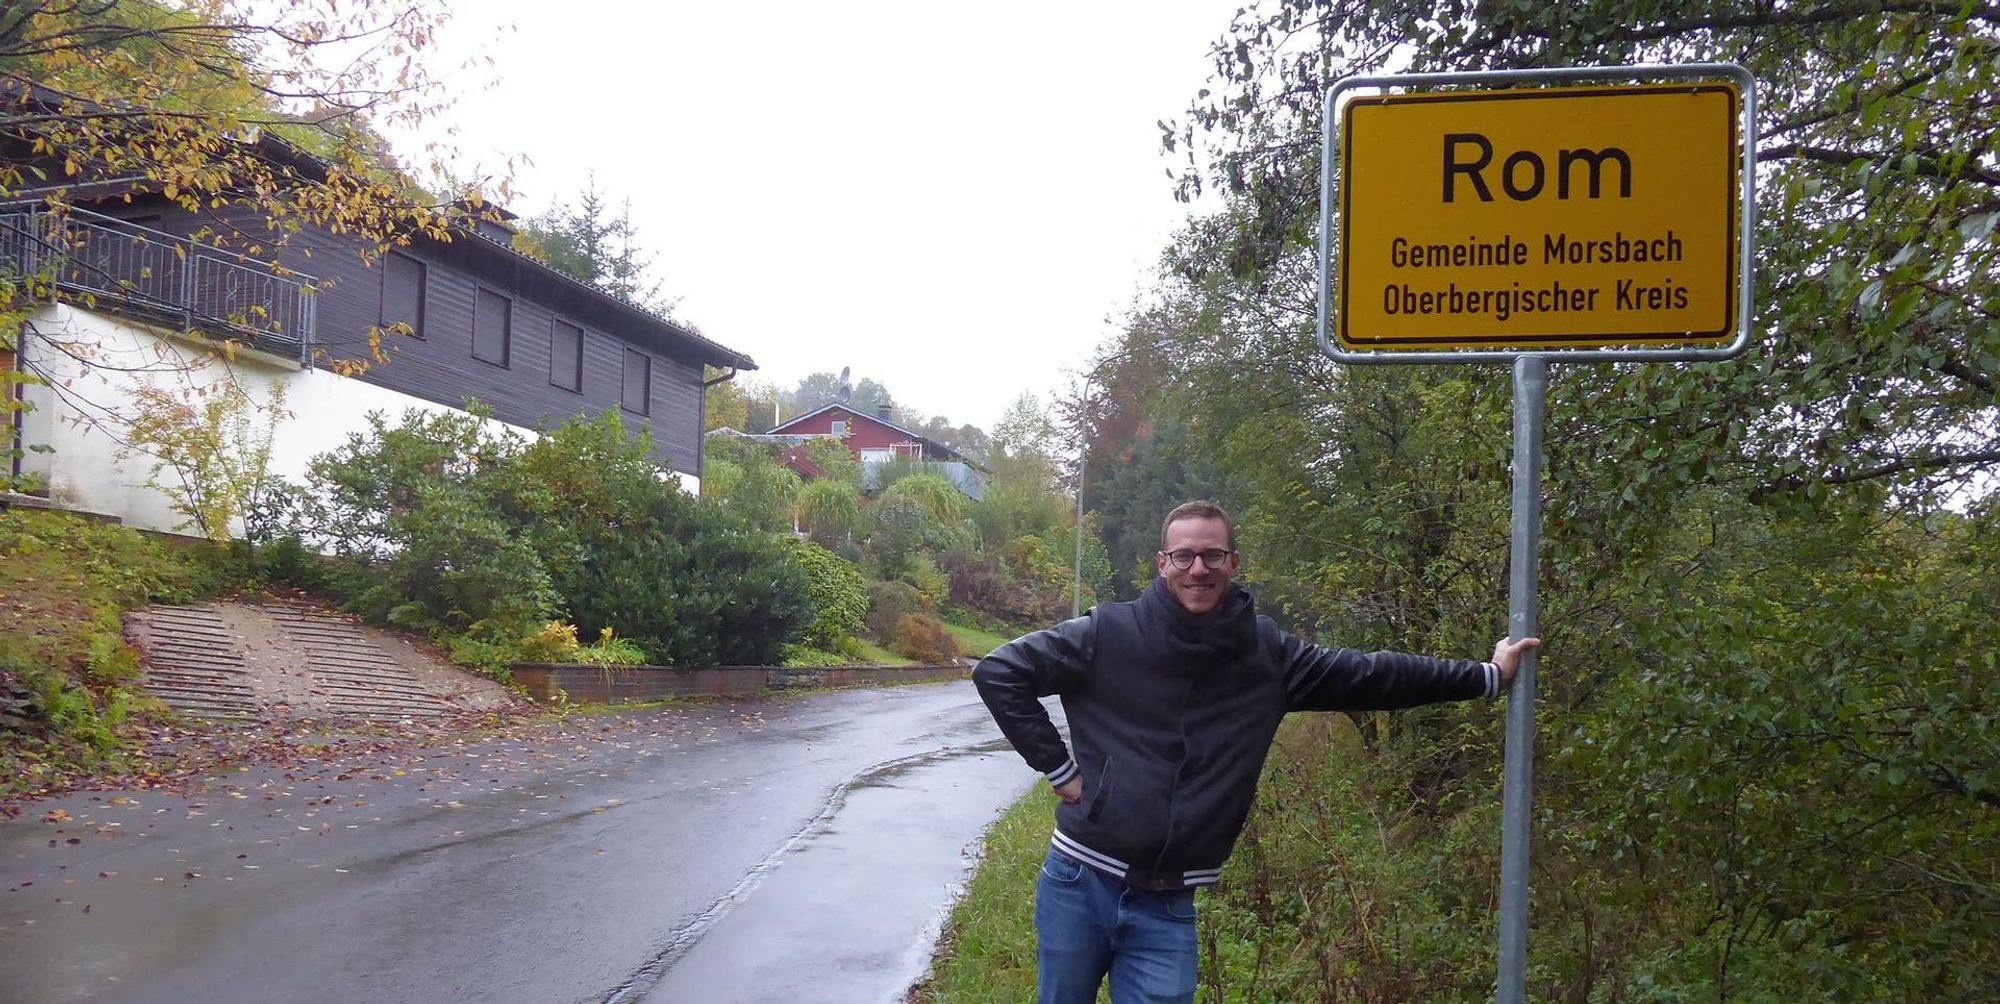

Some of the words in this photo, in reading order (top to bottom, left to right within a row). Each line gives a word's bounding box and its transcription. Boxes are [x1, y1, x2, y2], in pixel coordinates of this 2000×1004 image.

[1443, 133, 1631, 203] Rom
[1392, 235, 1527, 268] Gemeinde
[1544, 230, 1682, 264] Morsbach
[1384, 281, 1599, 321] Oberbergischer
[1616, 278, 1688, 310] Kreis
